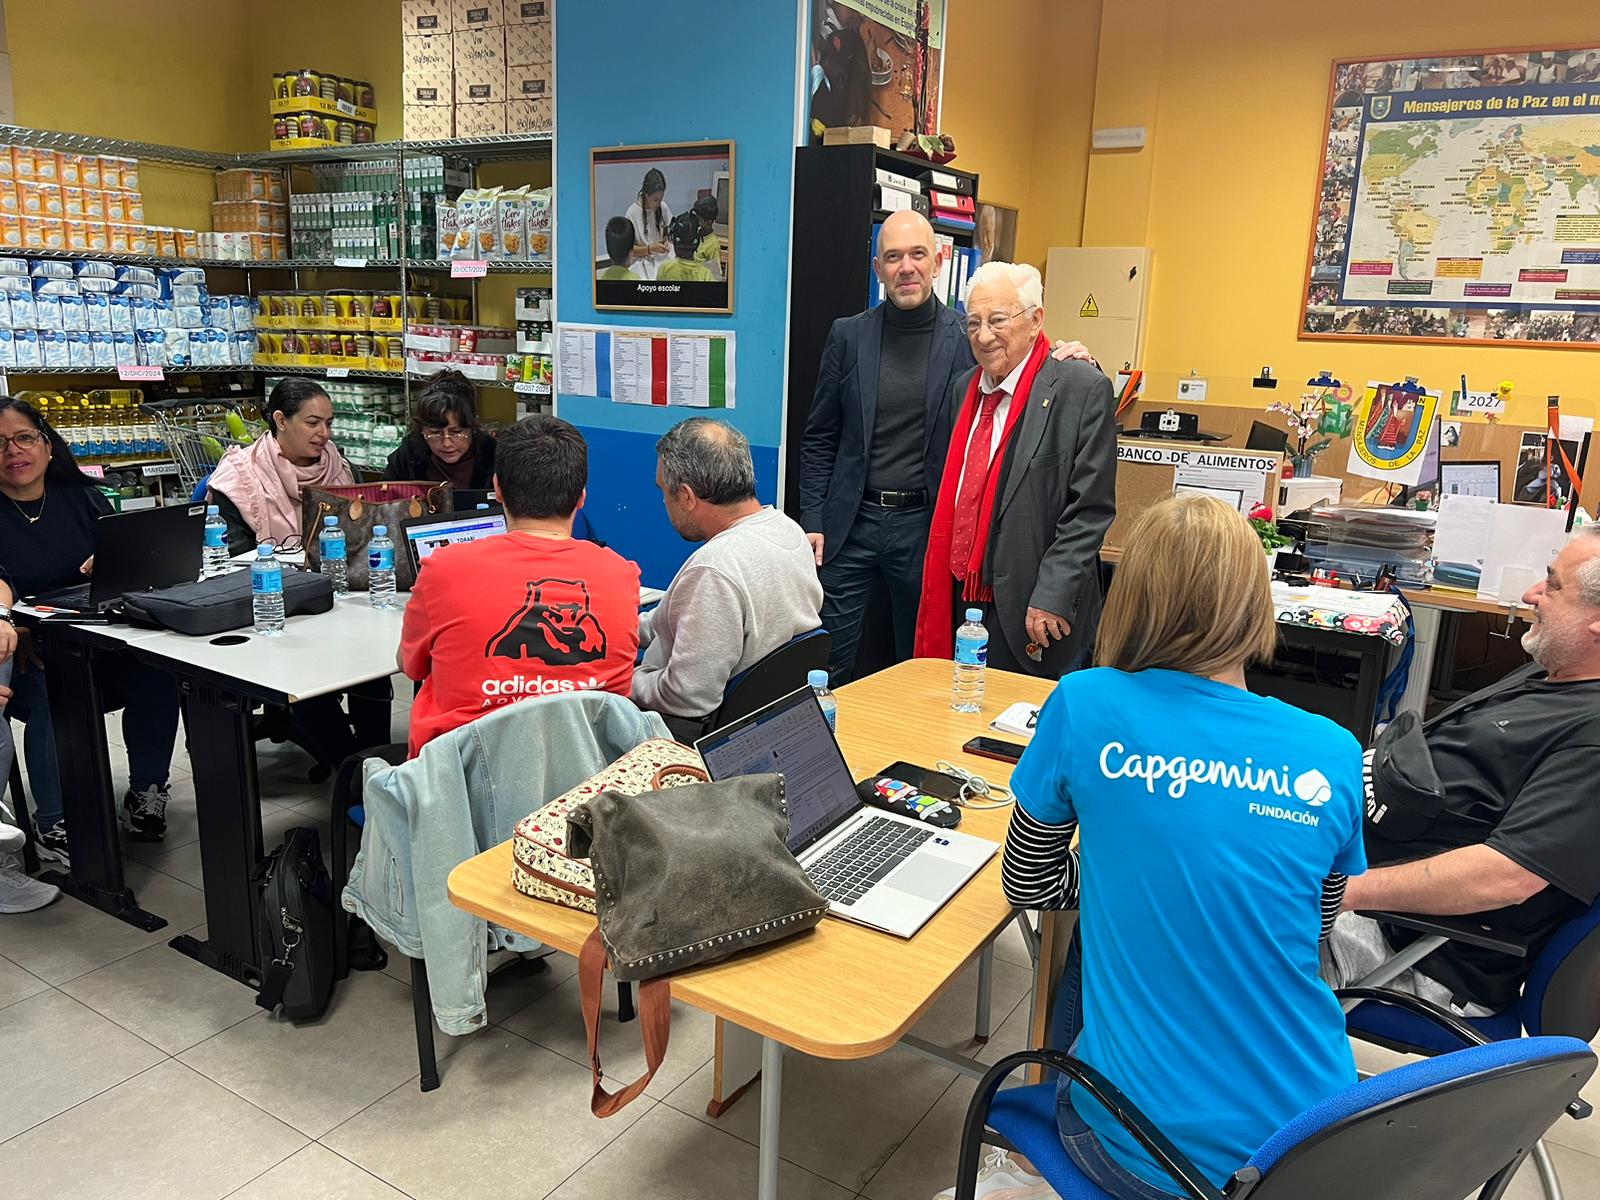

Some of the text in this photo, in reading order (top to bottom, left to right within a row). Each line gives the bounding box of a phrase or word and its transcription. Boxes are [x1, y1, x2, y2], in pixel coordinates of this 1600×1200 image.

[1403, 98, 1483, 114] Mensajeros
[1486, 96, 1503, 111] de
[1506, 96, 1519, 109] la
[1522, 94, 1549, 109] Paz
[1552, 95, 1570, 107] en
[1573, 92, 1587, 107] el
[502, 218, 520, 230] flakes
[528, 218, 549, 230] flakes
[637, 283, 681, 293] Apoyo escolar
[1468, 395, 1502, 408] 2027
[1355, 420, 1426, 468] MENSAJEROS DE LA PAZ
[1117, 446, 1163, 462] BANCO
[1197, 454, 1275, 471] ALIMENTOS
[481, 675, 575, 696] adidas
[1099, 741, 1292, 799] Capgemini
[1248, 802, 1320, 827] FUNDACIÓN
